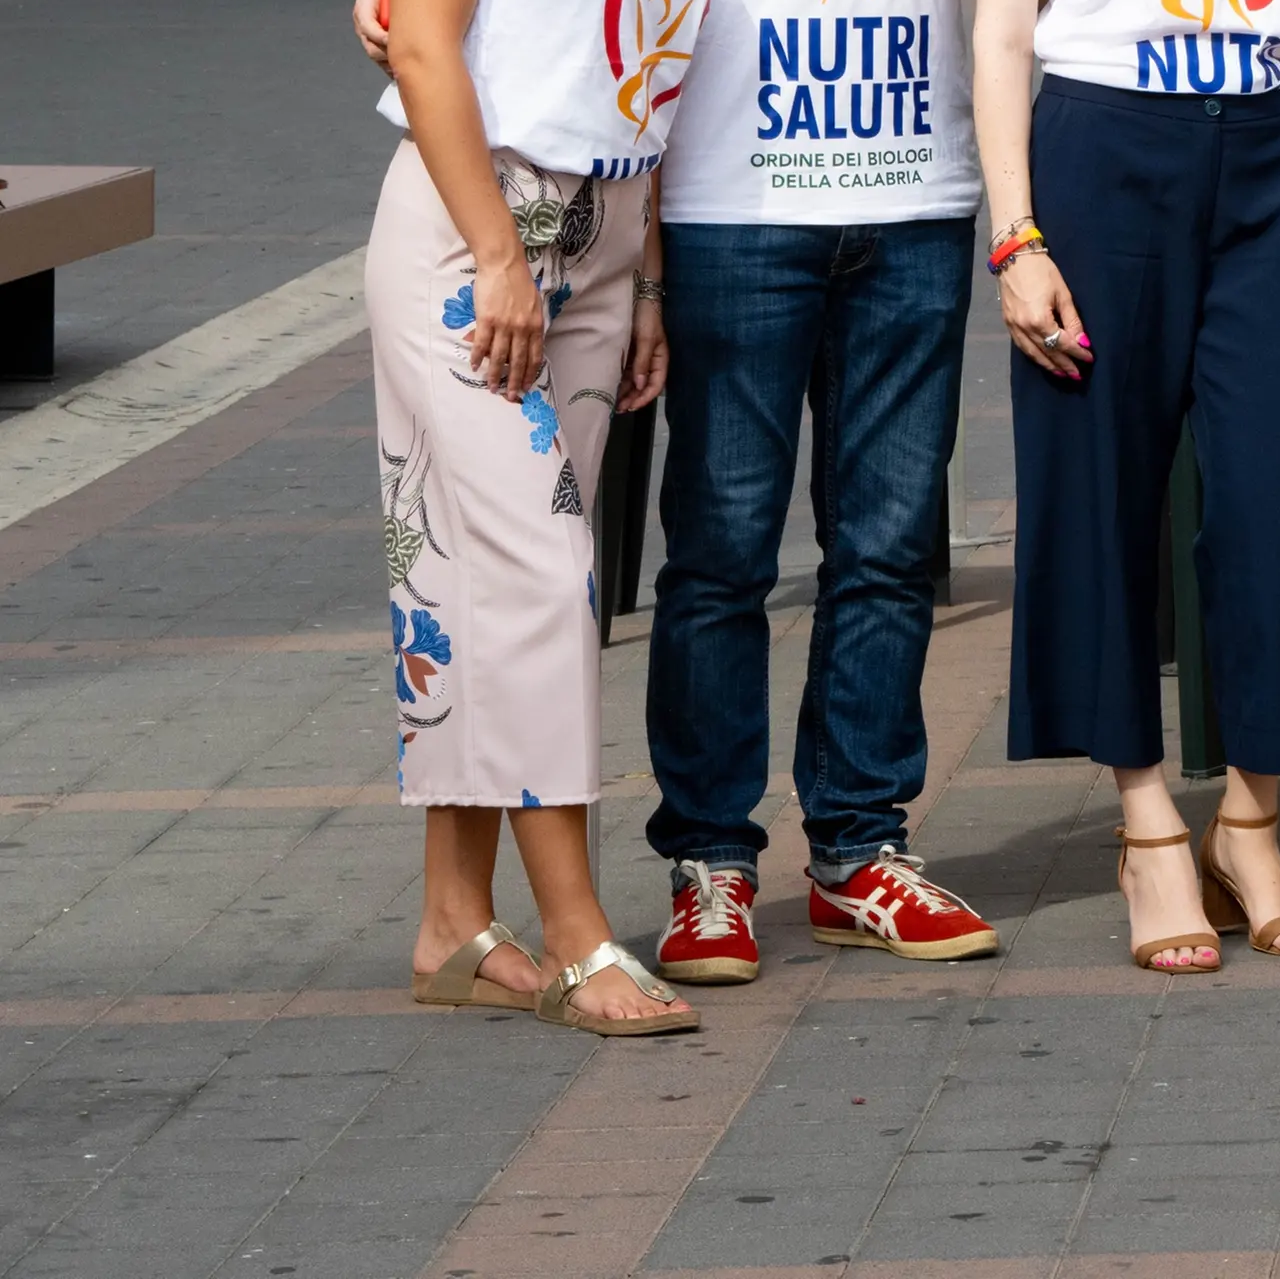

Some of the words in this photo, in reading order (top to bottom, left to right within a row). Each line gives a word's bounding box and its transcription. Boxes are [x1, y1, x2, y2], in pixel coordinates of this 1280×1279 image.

[759, 15, 929, 81] NUTRI
[757, 80, 932, 140] SALUTE
[751, 153, 824, 168] ORDINE
[832, 153, 861, 166] DEI
[868, 148, 932, 166] BIOLOGI
[772, 174, 831, 188] DELLA
[838, 170, 923, 188] CALABRIA
